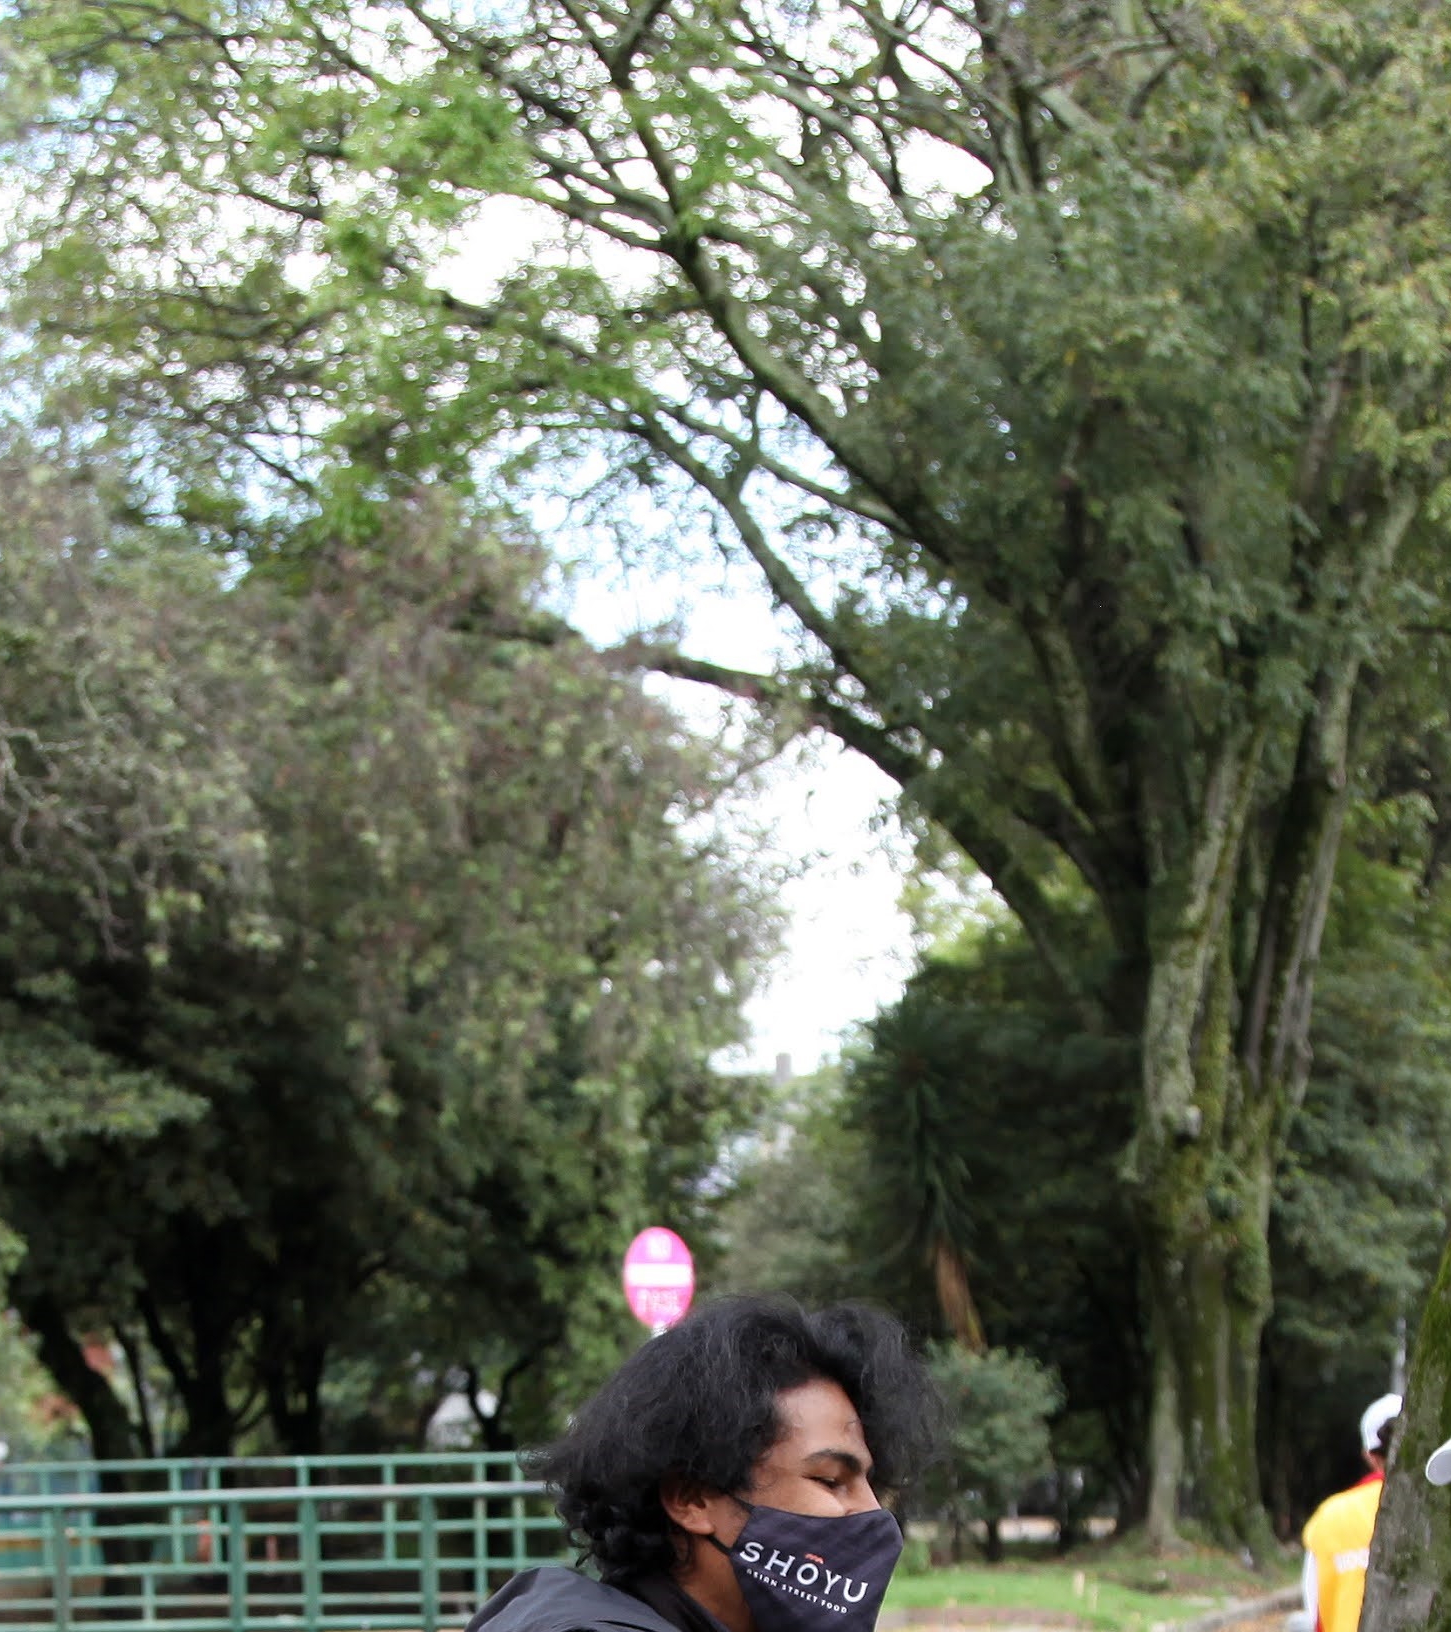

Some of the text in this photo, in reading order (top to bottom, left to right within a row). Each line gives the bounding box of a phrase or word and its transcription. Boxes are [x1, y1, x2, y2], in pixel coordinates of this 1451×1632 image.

[746, 1568, 848, 1614] ASIAN STREET FOOD
